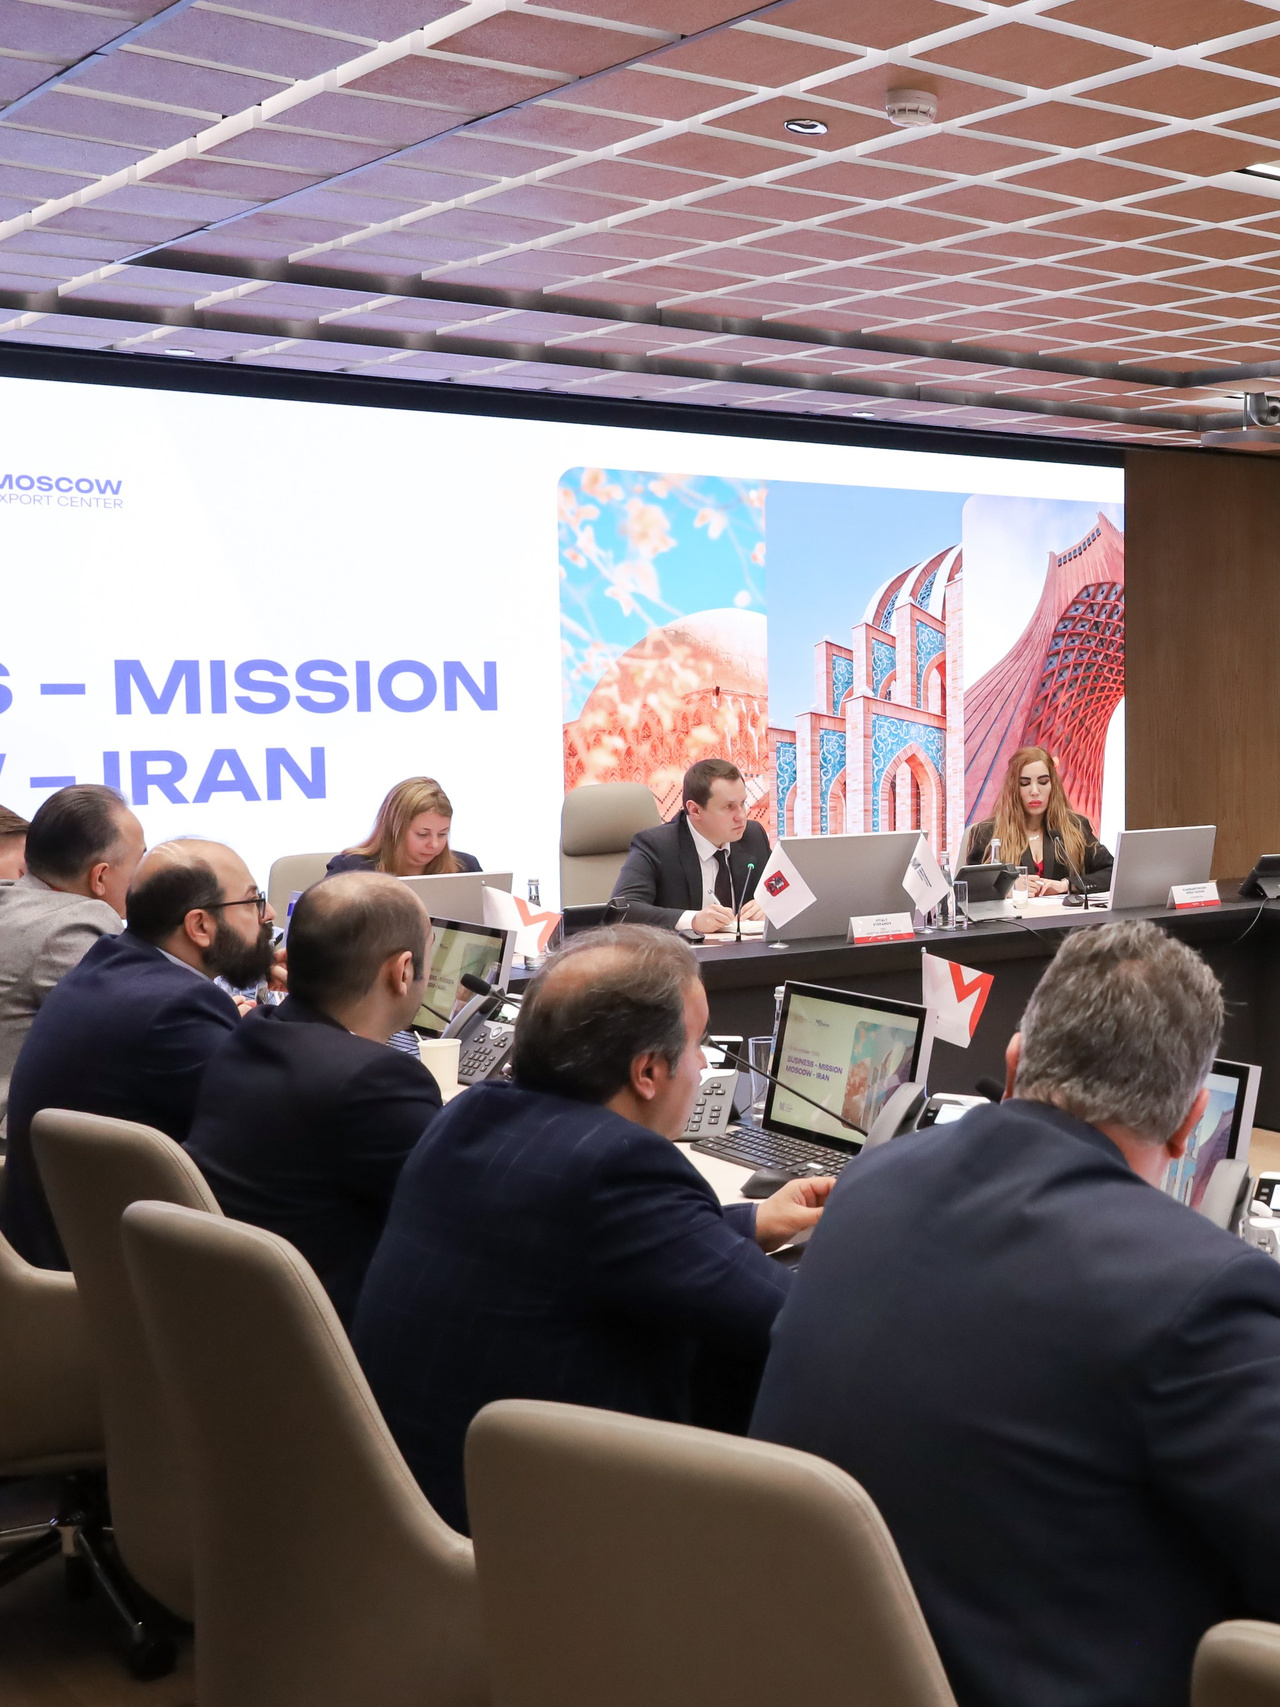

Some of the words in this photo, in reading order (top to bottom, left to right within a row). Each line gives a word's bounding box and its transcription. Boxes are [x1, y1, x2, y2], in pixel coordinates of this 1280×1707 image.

[0, 474, 122, 495] MOSCOW
[0, 493, 53, 506] XPORT
[57, 496, 123, 509] CENTER
[114, 658, 499, 715] MISSION
[103, 746, 326, 806] IRAN
[786, 1065, 812, 1077] MOSCOW
[816, 1072, 830, 1082] IRAN
[787, 1055, 815, 1068] BUSINESS
[818, 1063, 843, 1074] MISSION
